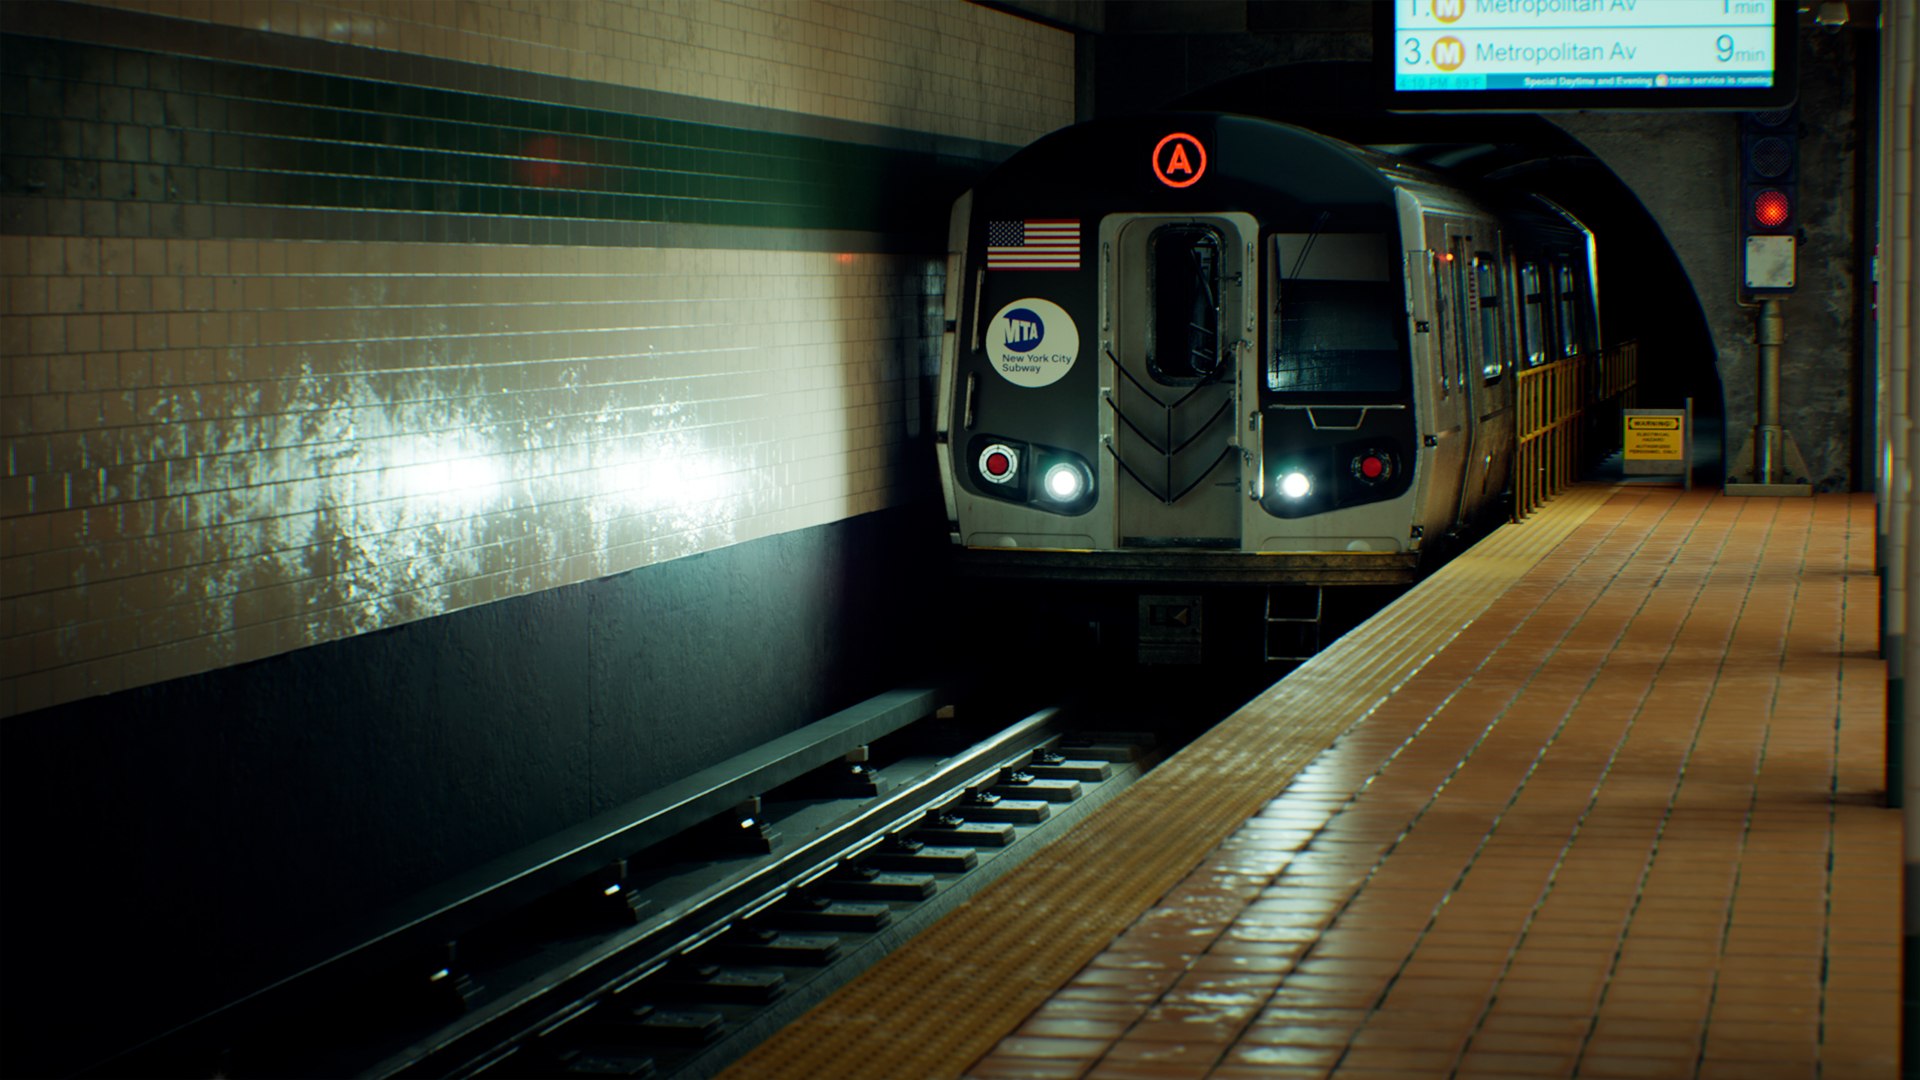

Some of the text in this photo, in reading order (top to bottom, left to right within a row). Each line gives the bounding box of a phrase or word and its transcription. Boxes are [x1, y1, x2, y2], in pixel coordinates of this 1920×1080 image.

[1476, 0, 1604, 16] Metropolitan
[1610, 0, 1637, 12] Av
[1435, 41, 1461, 66] M
[1476, 42, 1604, 65] Metropolitan
[1610, 41, 1637, 60] Av
[1524, 77, 1557, 89] Special
[1559, 77, 1595, 89] Daytime
[1597, 77, 1615, 86] and
[1616, 76, 1654, 88] Evening
[1669, 76, 1692, 86] train
[1693, 77, 1726, 86] service
[1727, 76, 1736, 86] is
[1737, 76, 1773, 87] running
[1165, 142, 1193, 175] A
[1002, 317, 1039, 344] MTA
[1002, 354, 1072, 365] New York City
[1002, 364, 1041, 374] Subway
